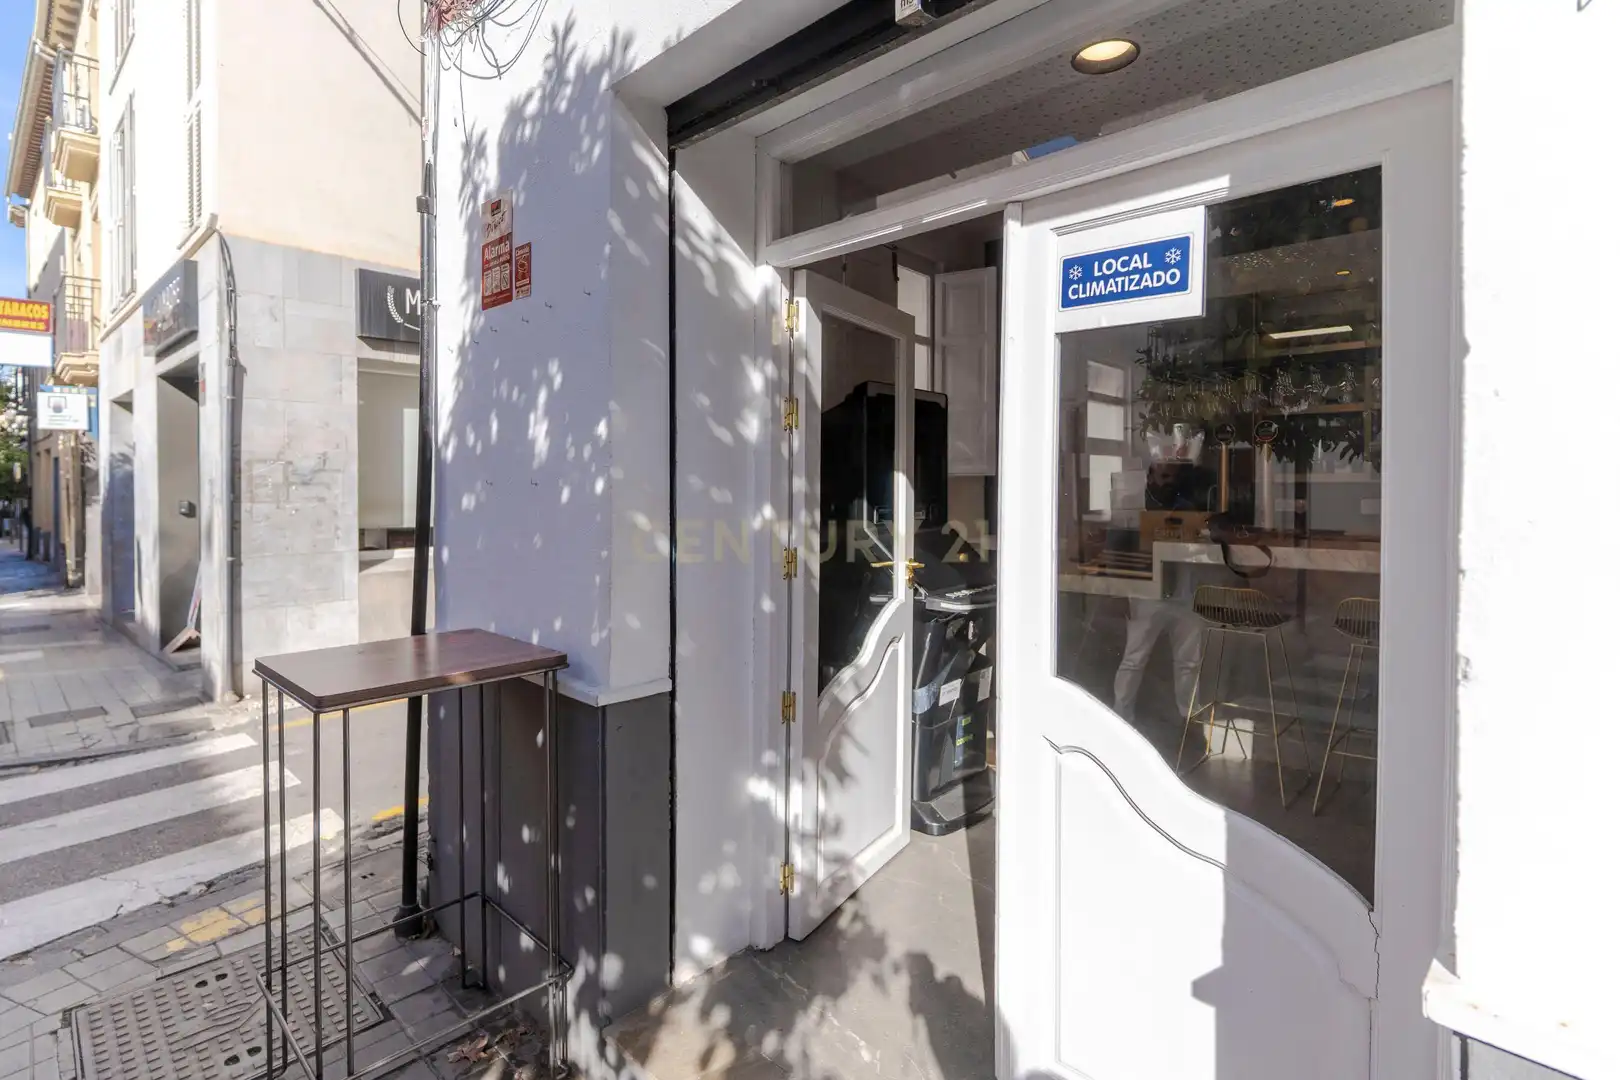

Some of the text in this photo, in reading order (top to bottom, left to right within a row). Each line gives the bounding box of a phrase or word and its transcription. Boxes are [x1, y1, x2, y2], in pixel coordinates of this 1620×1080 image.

[484, 240, 510, 261] Alarma
[1093, 252, 1152, 277] LOCAL
[1068, 268, 1181, 300] CLIMATIZADO
